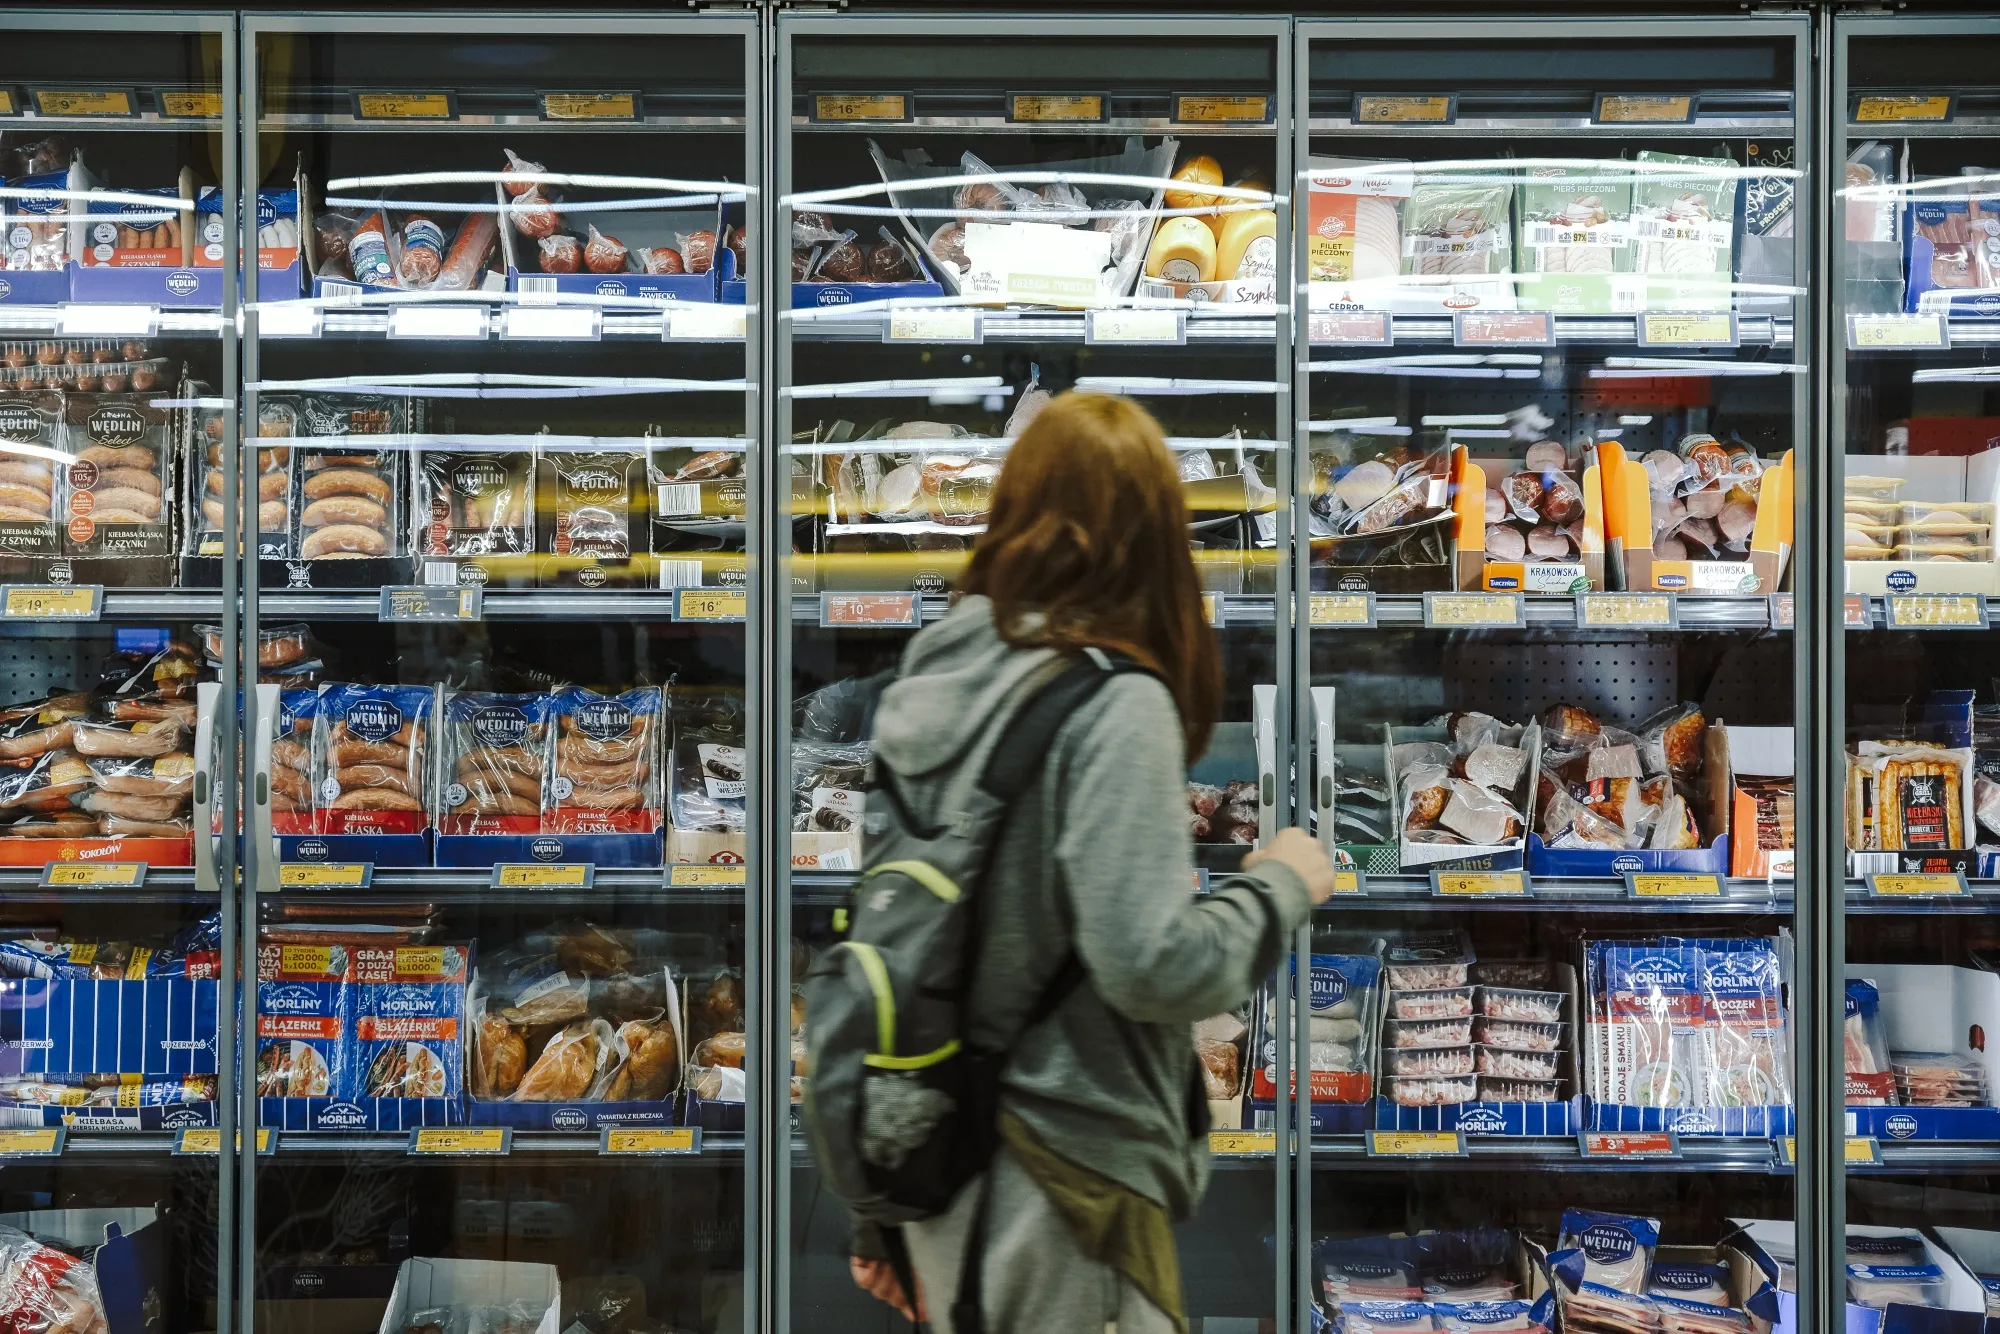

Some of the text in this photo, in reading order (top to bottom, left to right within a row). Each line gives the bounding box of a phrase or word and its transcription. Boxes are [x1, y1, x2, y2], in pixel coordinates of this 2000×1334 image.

[1554, 184, 1617, 192] PIERŚ PIECZONA
[168, 280, 197, 288] WĘDLIN
[598, 287, 625, 296] WĘDLIN
[639, 292, 676, 300] ŻYWIECKA
[818, 294, 850, 306] WĘDLIN
[92, 420, 141, 434] WĘDLIN
[313, 426, 340, 434] GRILL
[98, 434, 132, 446] Select
[74, 474, 92, 482] 105g
[456, 473, 504, 486] WĘDLIN
[570, 478, 619, 492] WĘDLIN
[578, 494, 610, 503] Select
[2, 528, 32, 536] KIEŁBASA
[138, 530, 164, 538] ŚLĄSKA
[0, 536, 41, 546] Z SZYNKI
[108, 540, 147, 548] Z SZYNKI
[1530, 568, 1578, 577] KRAKOWSKA
[1699, 565, 1747, 575] KRAKOWSKA
[460, 572, 487, 581] WĘDLIN
[581, 572, 604, 581] WĘDLIN
[1340, 582, 1366, 590] WĘDLIN
[1658, 577, 1686, 586] TARCZYŃSKI
[1888, 577, 1915, 587] WĘDLIN
[359, 704, 388, 712] KRAINA
[350, 712, 398, 727] WĘDLIN
[476, 720, 526, 734] WĘDLIN
[577, 812, 607, 820] KIEŁBASA
[1906, 807, 1942, 818] KIEŁBASKI
[344, 814, 374, 822] KIEŁBASA
[79, 842, 122, 860] SOKOŁÓW
[299, 846, 326, 856] WĘDLIN
[534, 845, 560, 854] WĘDLIN
[1926, 858, 1948, 866] ZESTAW
[1614, 862, 1642, 872] WĘDLIN
[357, 970, 393, 982] KASĘ!
[1624, 972, 1688, 984] MORLINY
[266, 999, 322, 1010] MORLINY
[380, 1000, 436, 1011] MORLINY
[1712, 1000, 1756, 1010] BOCZEK
[264, 1020, 322, 1033] ŚLĄZERKI
[20, 1040, 54, 1048] ZERWAĆ
[172, 1040, 206, 1049] ZERWAĆ
[1617, 1026, 1626, 1064] SMAKU
[318, 1115, 368, 1124] MORLINY
[596, 1112, 626, 1120] ĆWIARTKA
[554, 1116, 586, 1126] WĘDLIN
[1455, 1122, 1507, 1131] MORLINY
[1670, 1124, 1717, 1133] MORLINY
[1888, 1122, 1916, 1130] WĘDLIN
[1594, 1228, 1624, 1238] KRAINA
[1584, 1236, 1632, 1252] WĘDLIN
[1344, 1265, 1391, 1274] WĘDLIN
[294, 1278, 322, 1287] WĘDLIN
[1660, 1276, 1708, 1285] WĘDLIN
